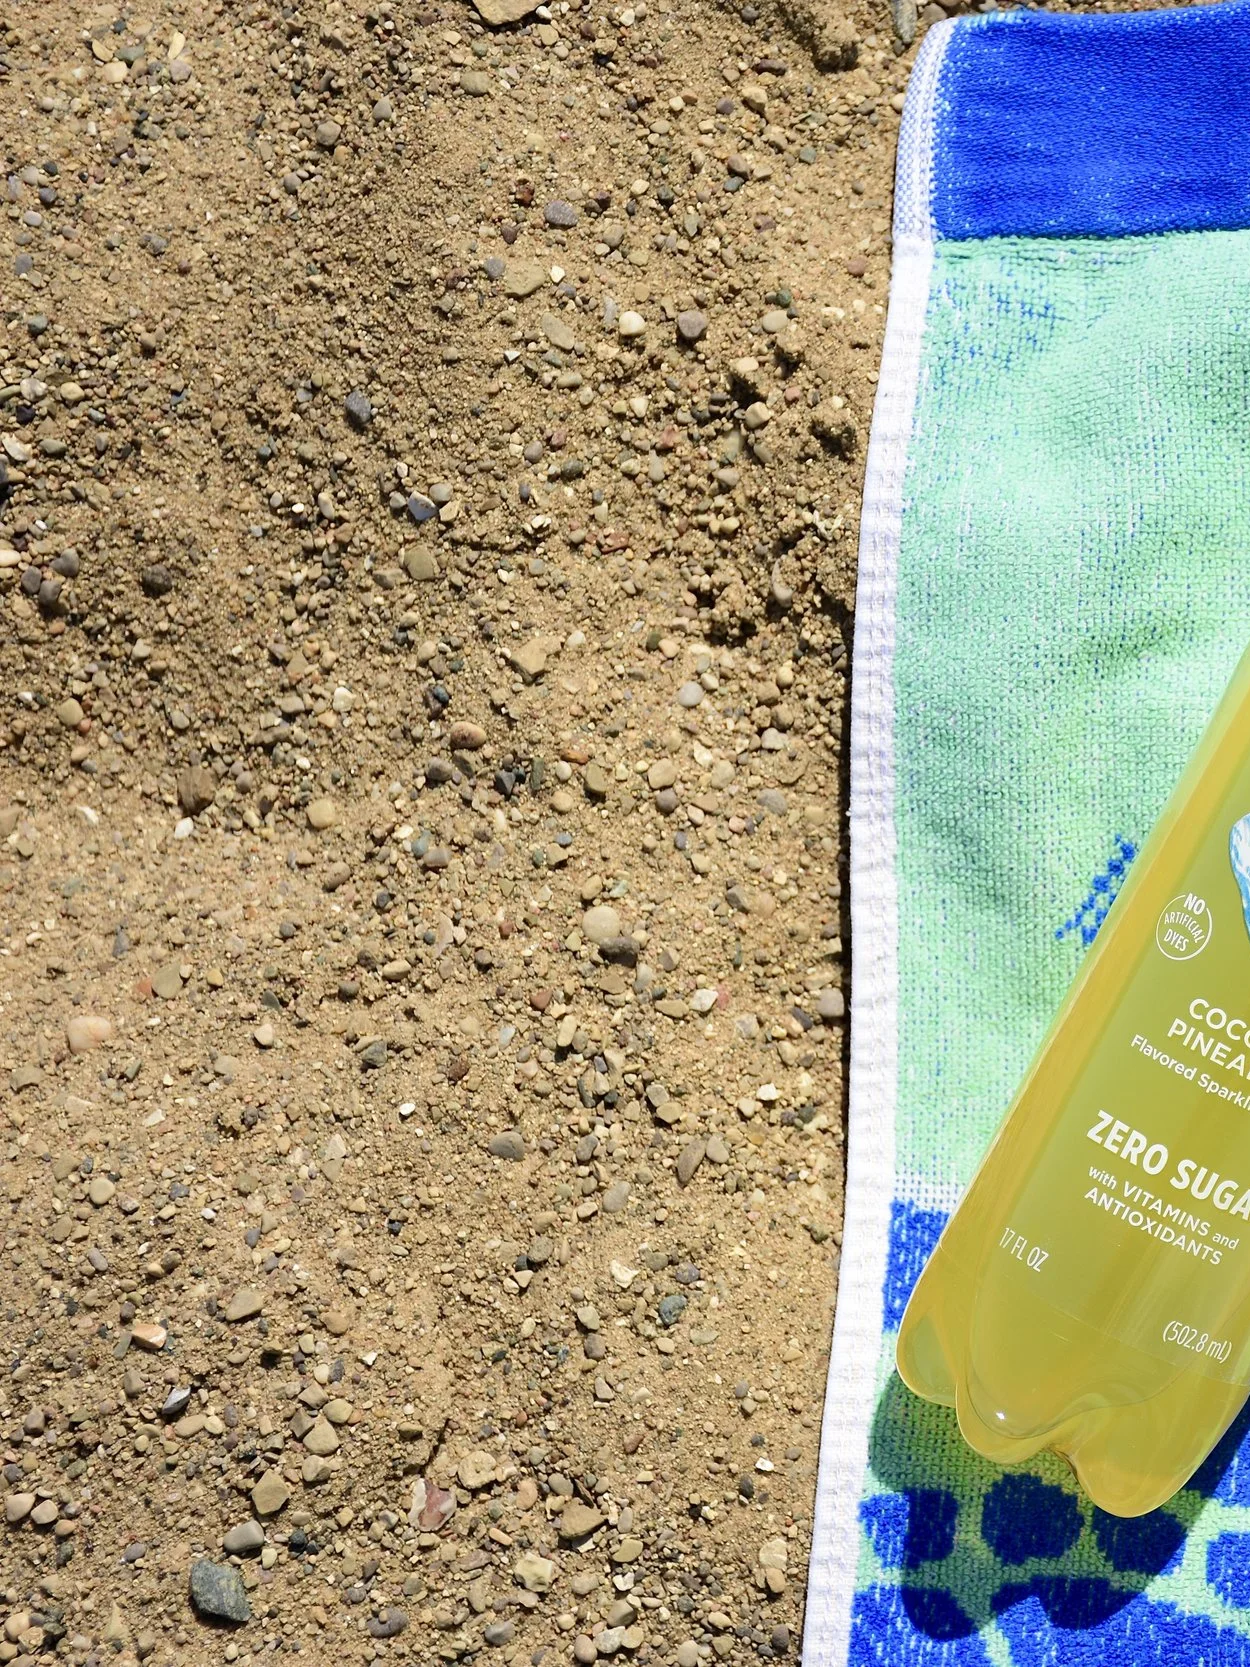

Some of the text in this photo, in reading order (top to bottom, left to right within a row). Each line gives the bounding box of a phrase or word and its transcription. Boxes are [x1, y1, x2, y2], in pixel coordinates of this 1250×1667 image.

[1183, 892, 1206, 915] NO
[1163, 928, 1190, 952] DYES
[1164, 911, 1205, 944] ARTIFICIAL
[1130, 1034, 1197, 1081] Flavored
[1086, 1110, 1169, 1175] ZERO
[1084, 1187, 1223, 1266] ANTIOXIDANTS
[1088, 1165, 1240, 1251] with VITAMINS and
[999, 1227, 1049, 1273] 17 FL OZ
[1162, 1320, 1233, 1364] (502.8 mL)
